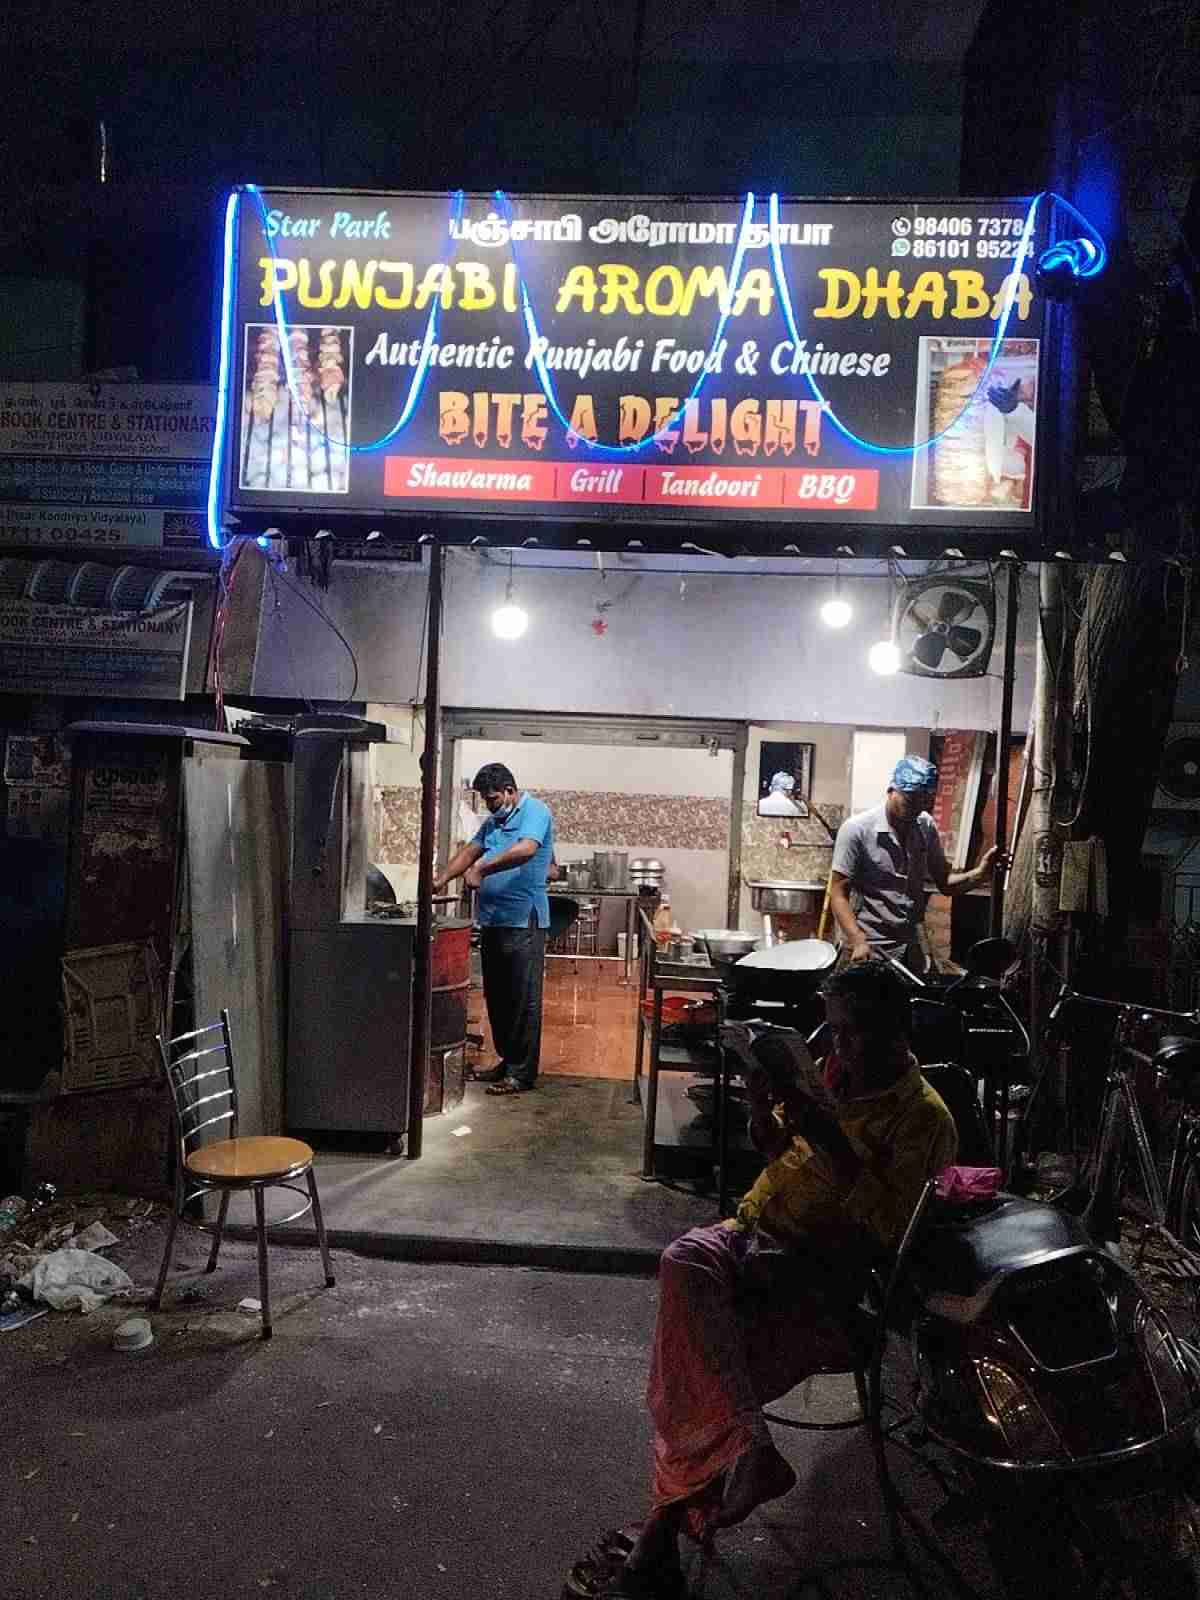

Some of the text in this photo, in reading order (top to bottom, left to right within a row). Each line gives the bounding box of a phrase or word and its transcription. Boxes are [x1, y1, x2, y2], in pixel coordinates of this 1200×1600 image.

[264, 210, 391, 240] Star Park
[449, 213, 583, 247] பஞ்சாபி
[588, 214, 735, 247] அரோமா
[914, 217, 972, 236] 98406
[912, 239, 969, 258] 86101
[258, 257, 1033, 321] PUNJABI AROMA DHABA
[365, 332, 892, 379] Authentic Punjabi Food & Chinese
[48, 412, 106, 430] CENTRE
[111, 413, 121, 431] &
[127, 414, 213, 433] STATIONAR
[438, 390, 832, 456] BITE A DELIGHT
[406, 457, 533, 491] Shawarma
[570, 467, 623, 494] Grill
[661, 470, 762, 497] Tandoori
[798, 474, 857, 504] BBQ
[32, 616, 83, 630] CENTRE
